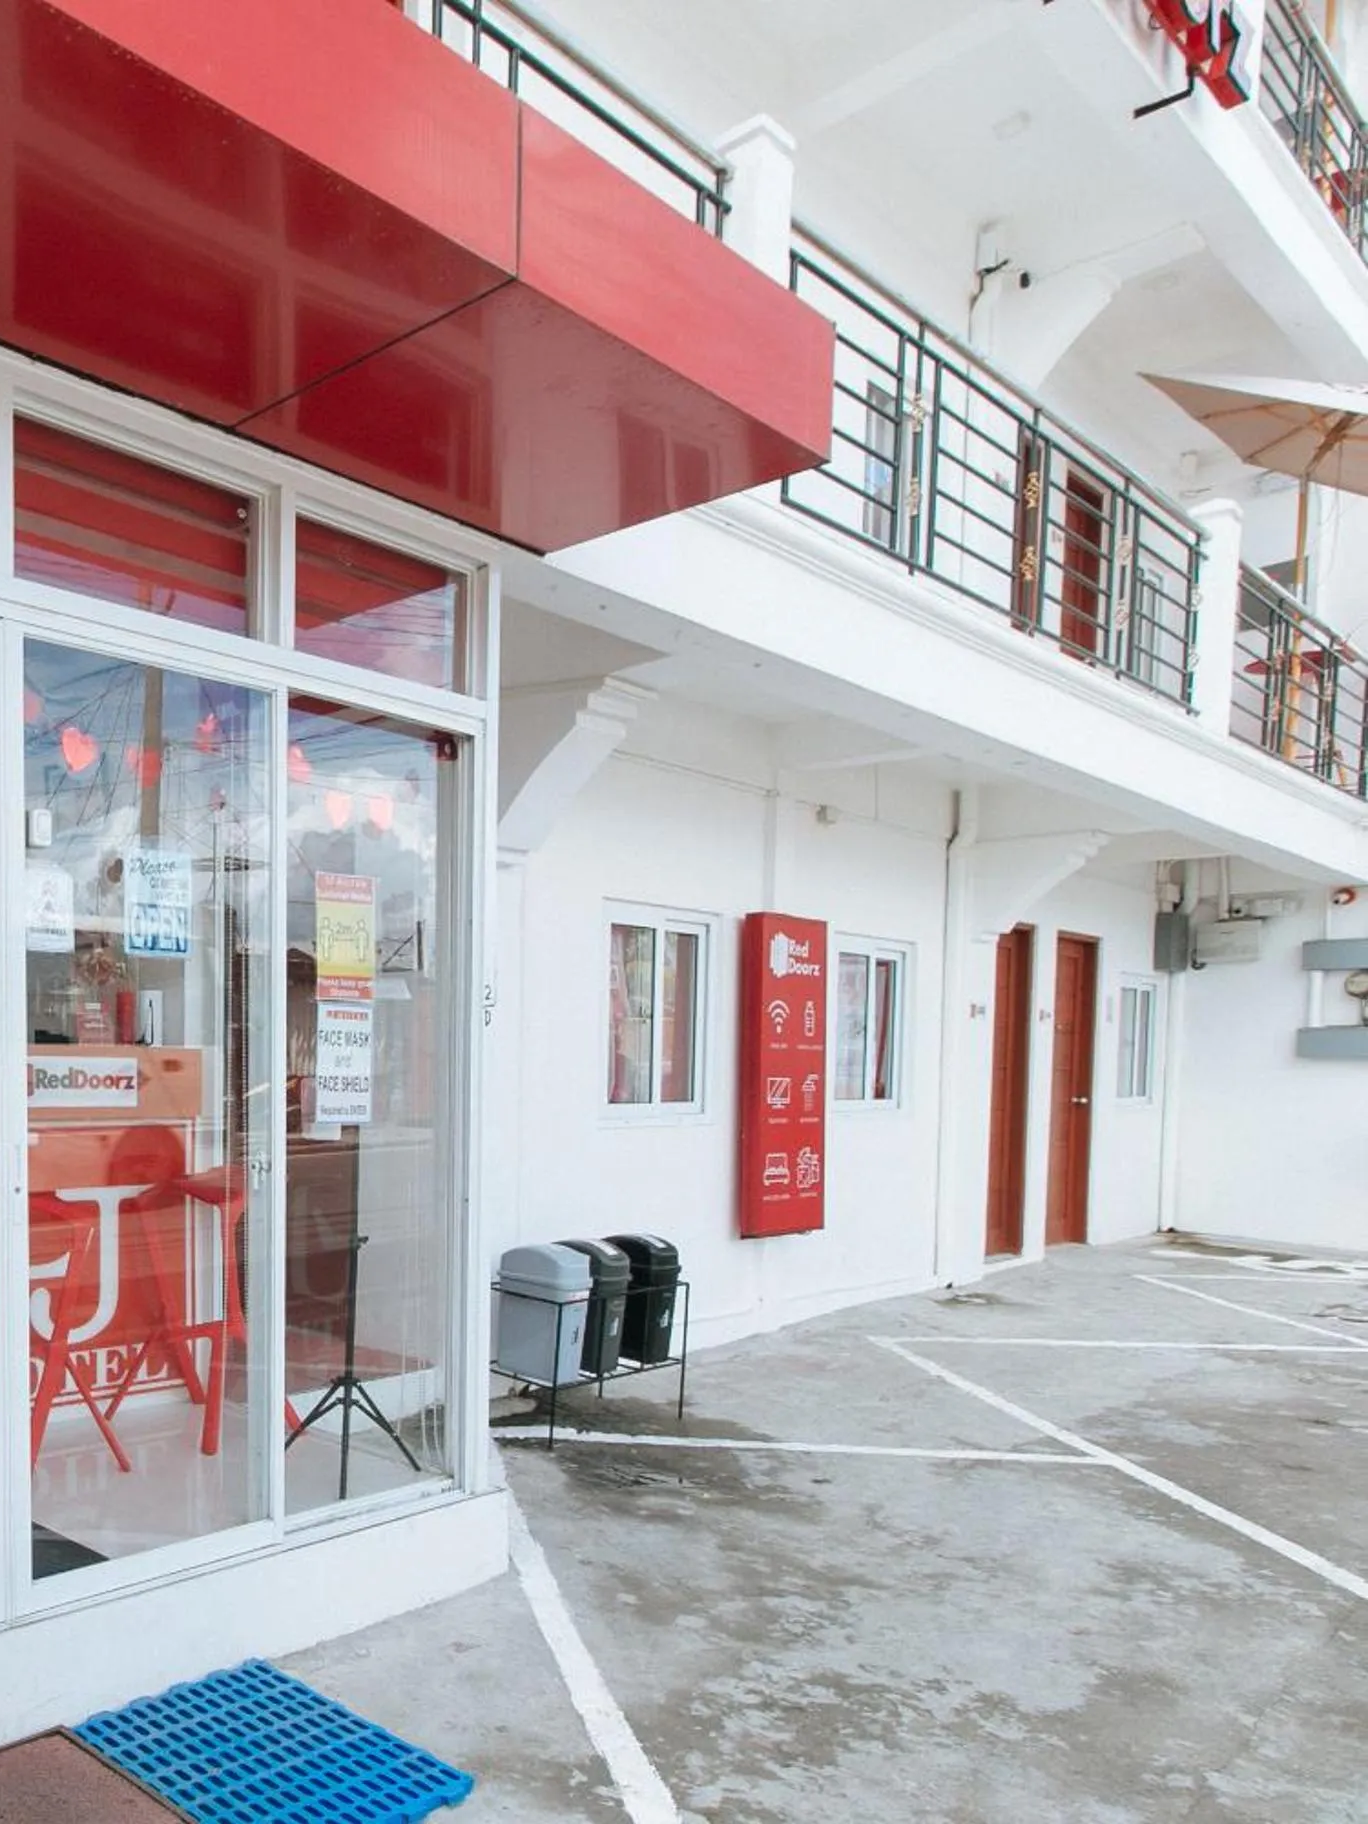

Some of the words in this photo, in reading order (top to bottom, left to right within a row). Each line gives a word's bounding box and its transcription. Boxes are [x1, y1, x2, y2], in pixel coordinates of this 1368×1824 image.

[131, 904, 187, 951] OPEN
[788, 939, 809, 958] Red
[787, 957, 821, 977] Doorz
[318, 1029, 343, 1046] FACE
[344, 1030, 371, 1048] MASK
[34, 1066, 135, 1090] RedDoorz
[318, 1075, 339, 1092] FACE
[340, 1075, 370, 1093] SHIELD
